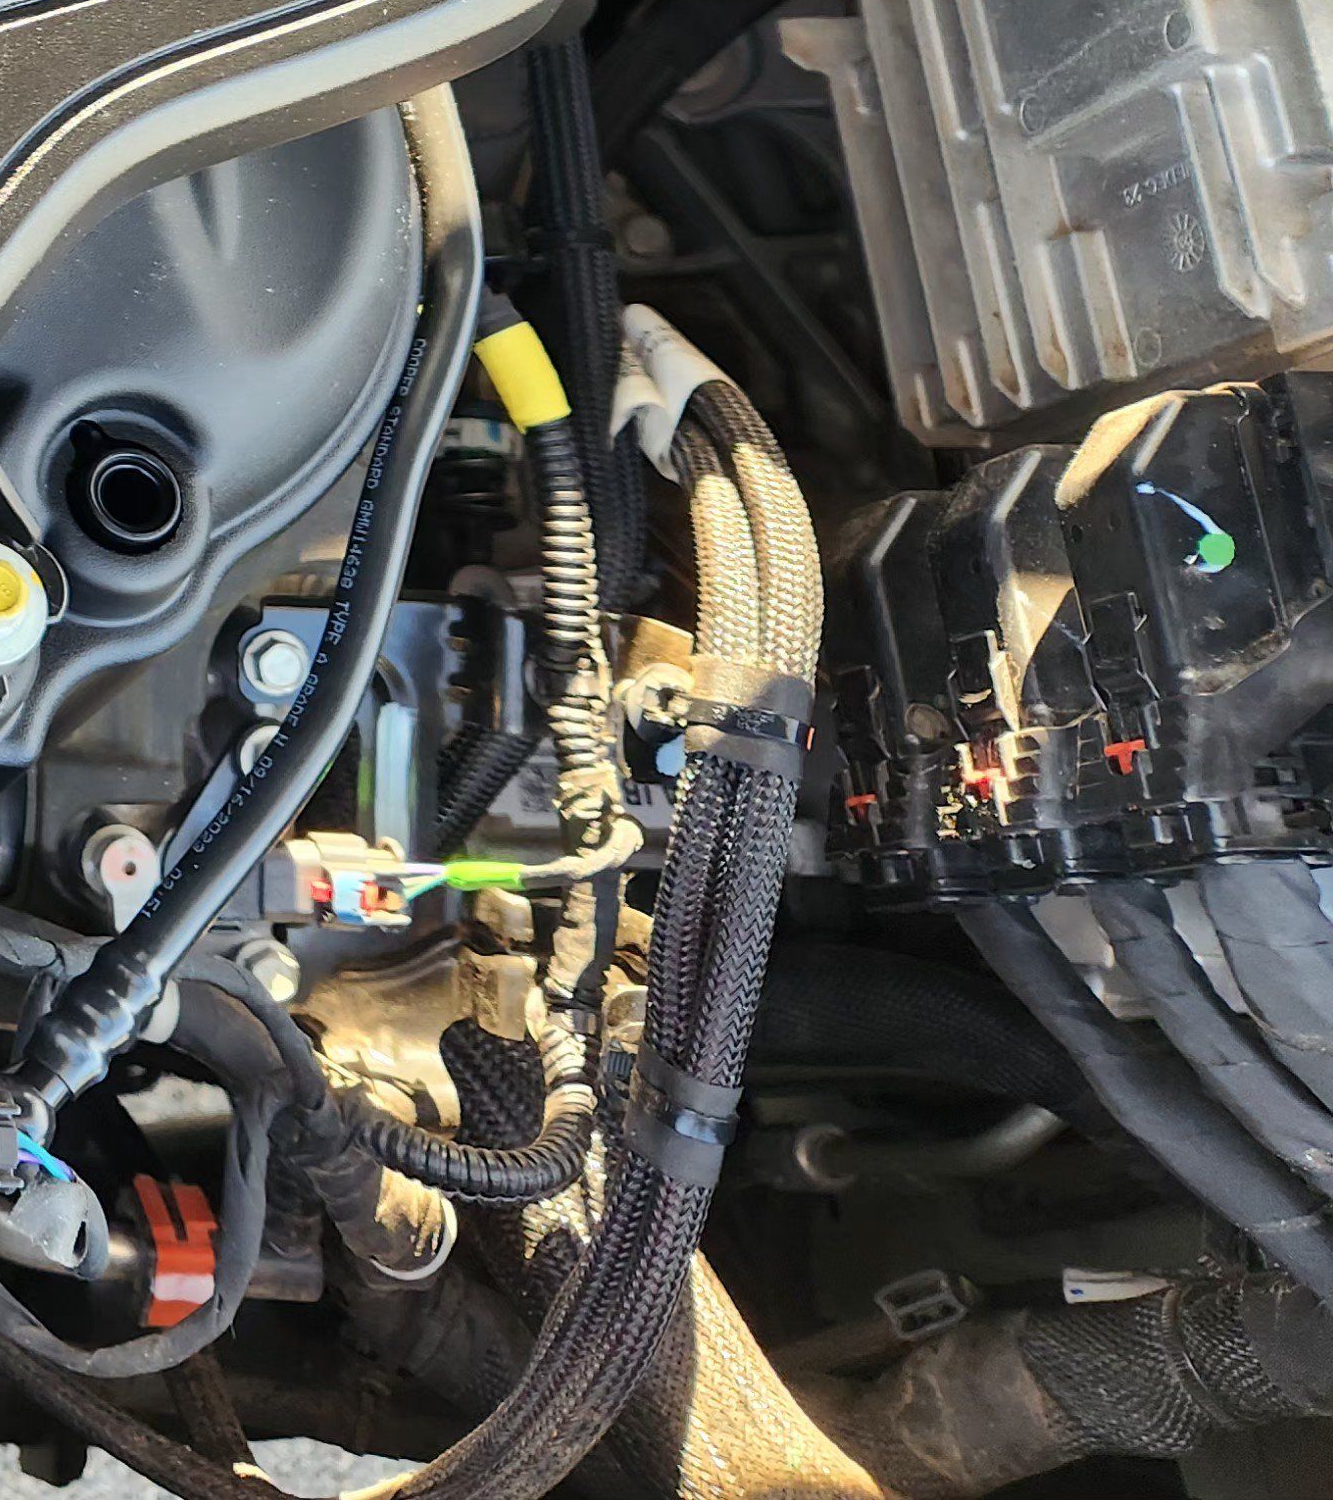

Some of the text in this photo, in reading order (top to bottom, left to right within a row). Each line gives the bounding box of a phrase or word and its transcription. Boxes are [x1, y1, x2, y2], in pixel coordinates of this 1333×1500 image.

[399, 337, 427, 397] COOPER
[366, 405, 402, 490] STANDARD
[327, 600, 350, 646] TYPE
[314, 652, 329, 665] A
[288, 672, 319, 728] GRADE
